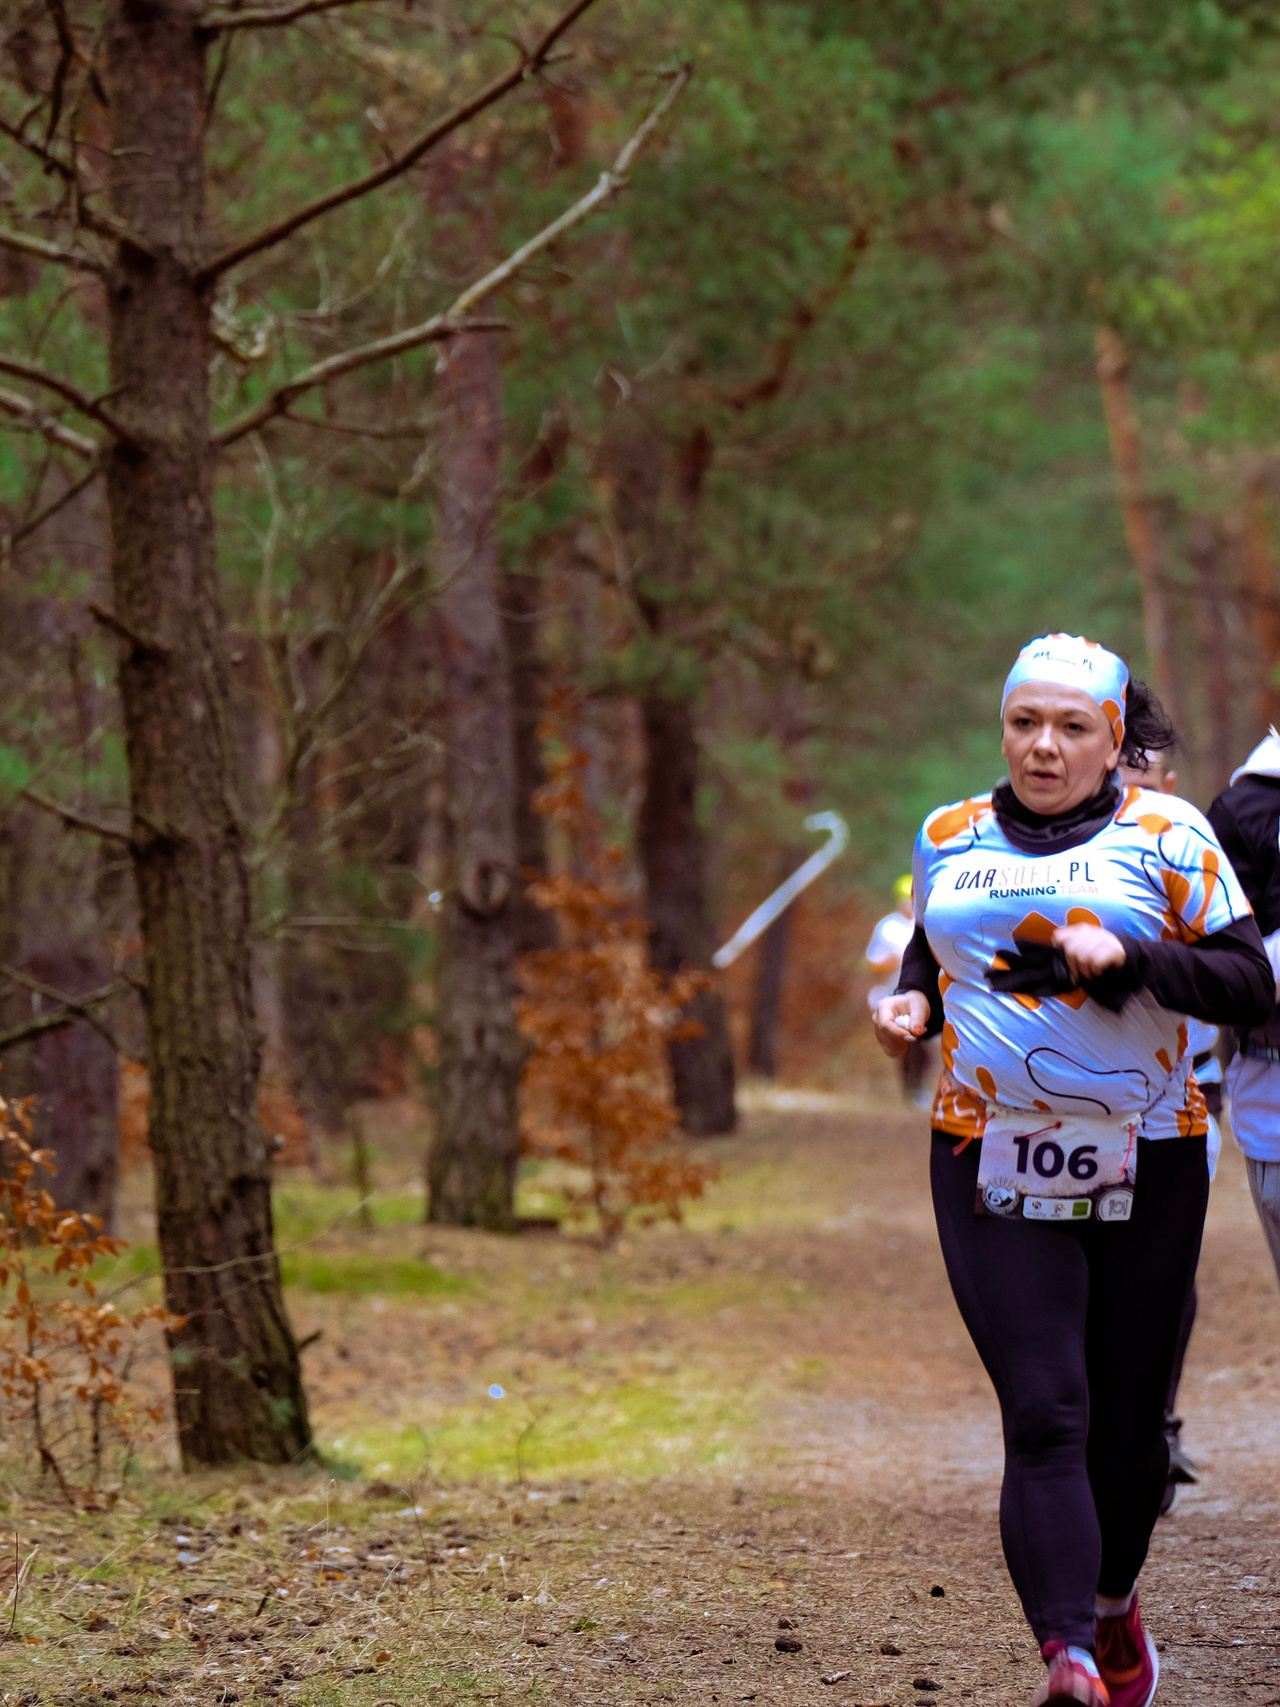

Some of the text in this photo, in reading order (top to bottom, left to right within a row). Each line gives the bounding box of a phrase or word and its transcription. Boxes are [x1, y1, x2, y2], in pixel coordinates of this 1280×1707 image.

[989, 883, 1099, 899] RUNNING TEAM
[1013, 1136, 1098, 1180] 106
